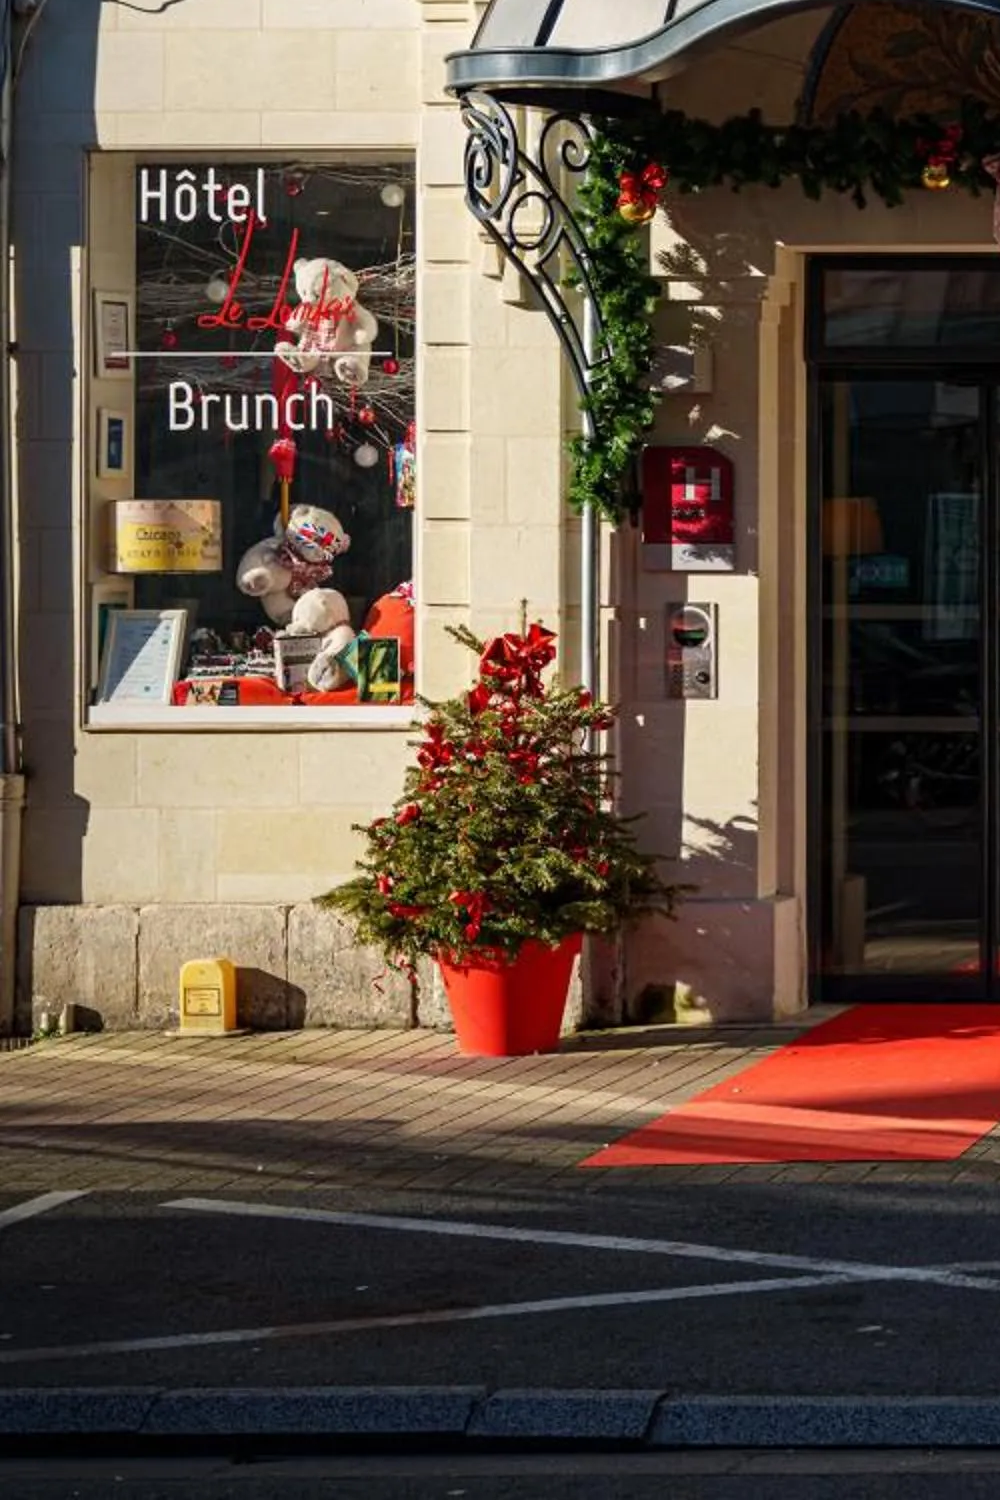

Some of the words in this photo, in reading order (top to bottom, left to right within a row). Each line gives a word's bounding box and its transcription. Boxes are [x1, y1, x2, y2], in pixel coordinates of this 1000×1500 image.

[140, 167, 266, 223] Hôtel
[197, 208, 254, 329] Le
[246, 228, 356, 331] Londres
[168, 382, 334, 431] Brunch
[685, 467, 721, 501] H
